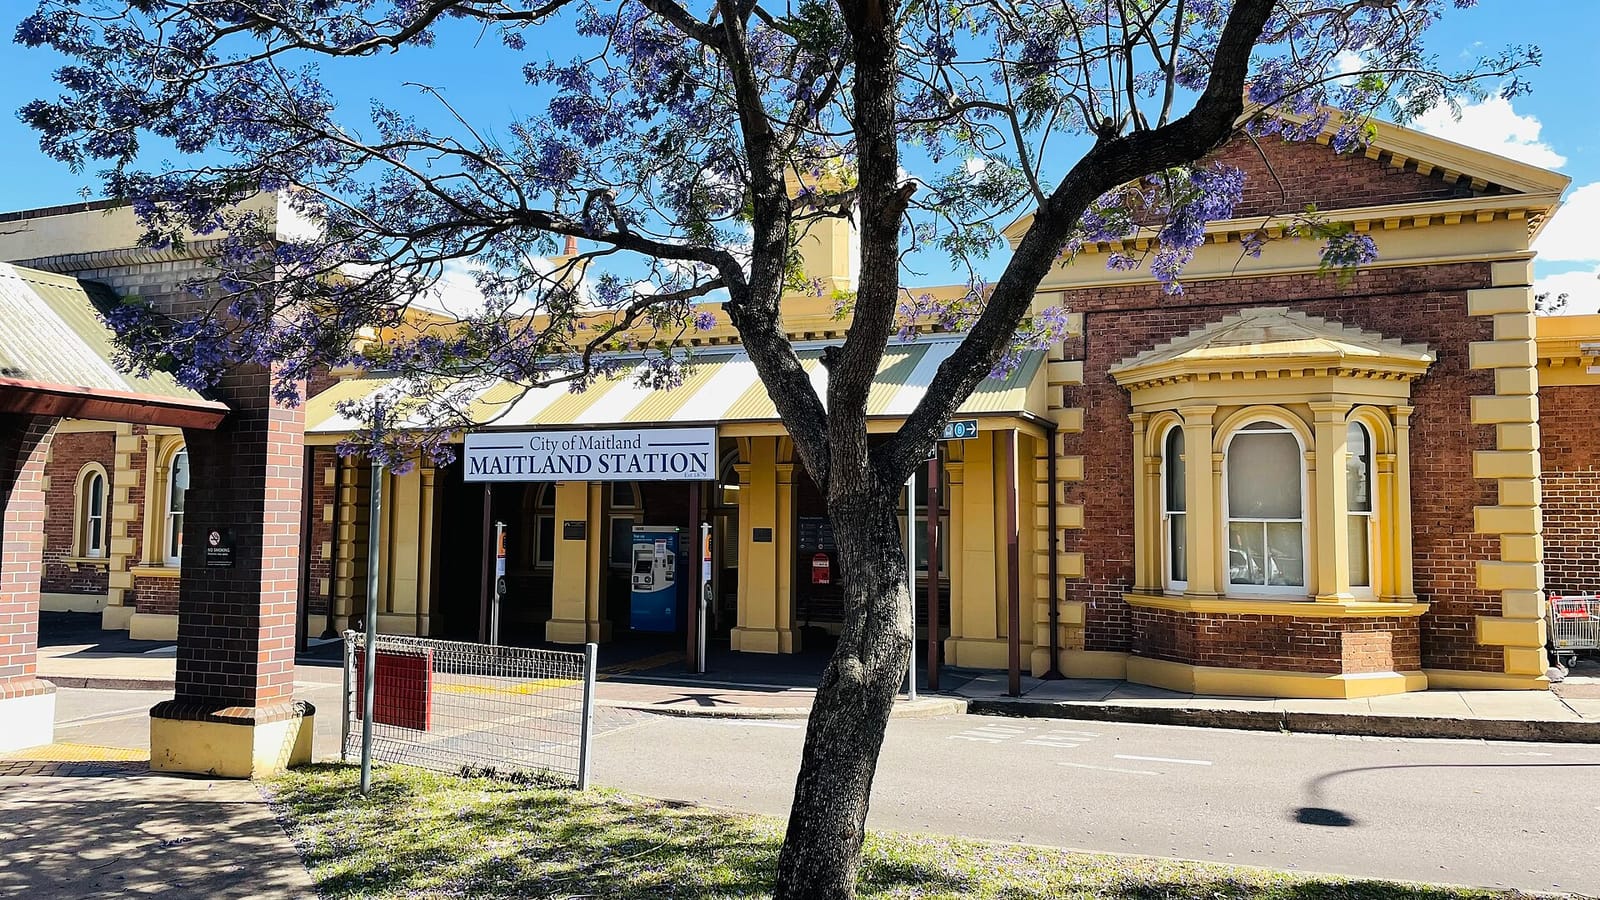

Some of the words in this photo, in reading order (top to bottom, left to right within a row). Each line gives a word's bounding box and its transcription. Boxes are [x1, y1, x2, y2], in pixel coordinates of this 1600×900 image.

[530, 436, 559, 455] City
[561, 435, 578, 450] of
[579, 434, 641, 450] Maitland
[469, 455, 592, 475] MAITLAND
[598, 452, 709, 474] STATION
